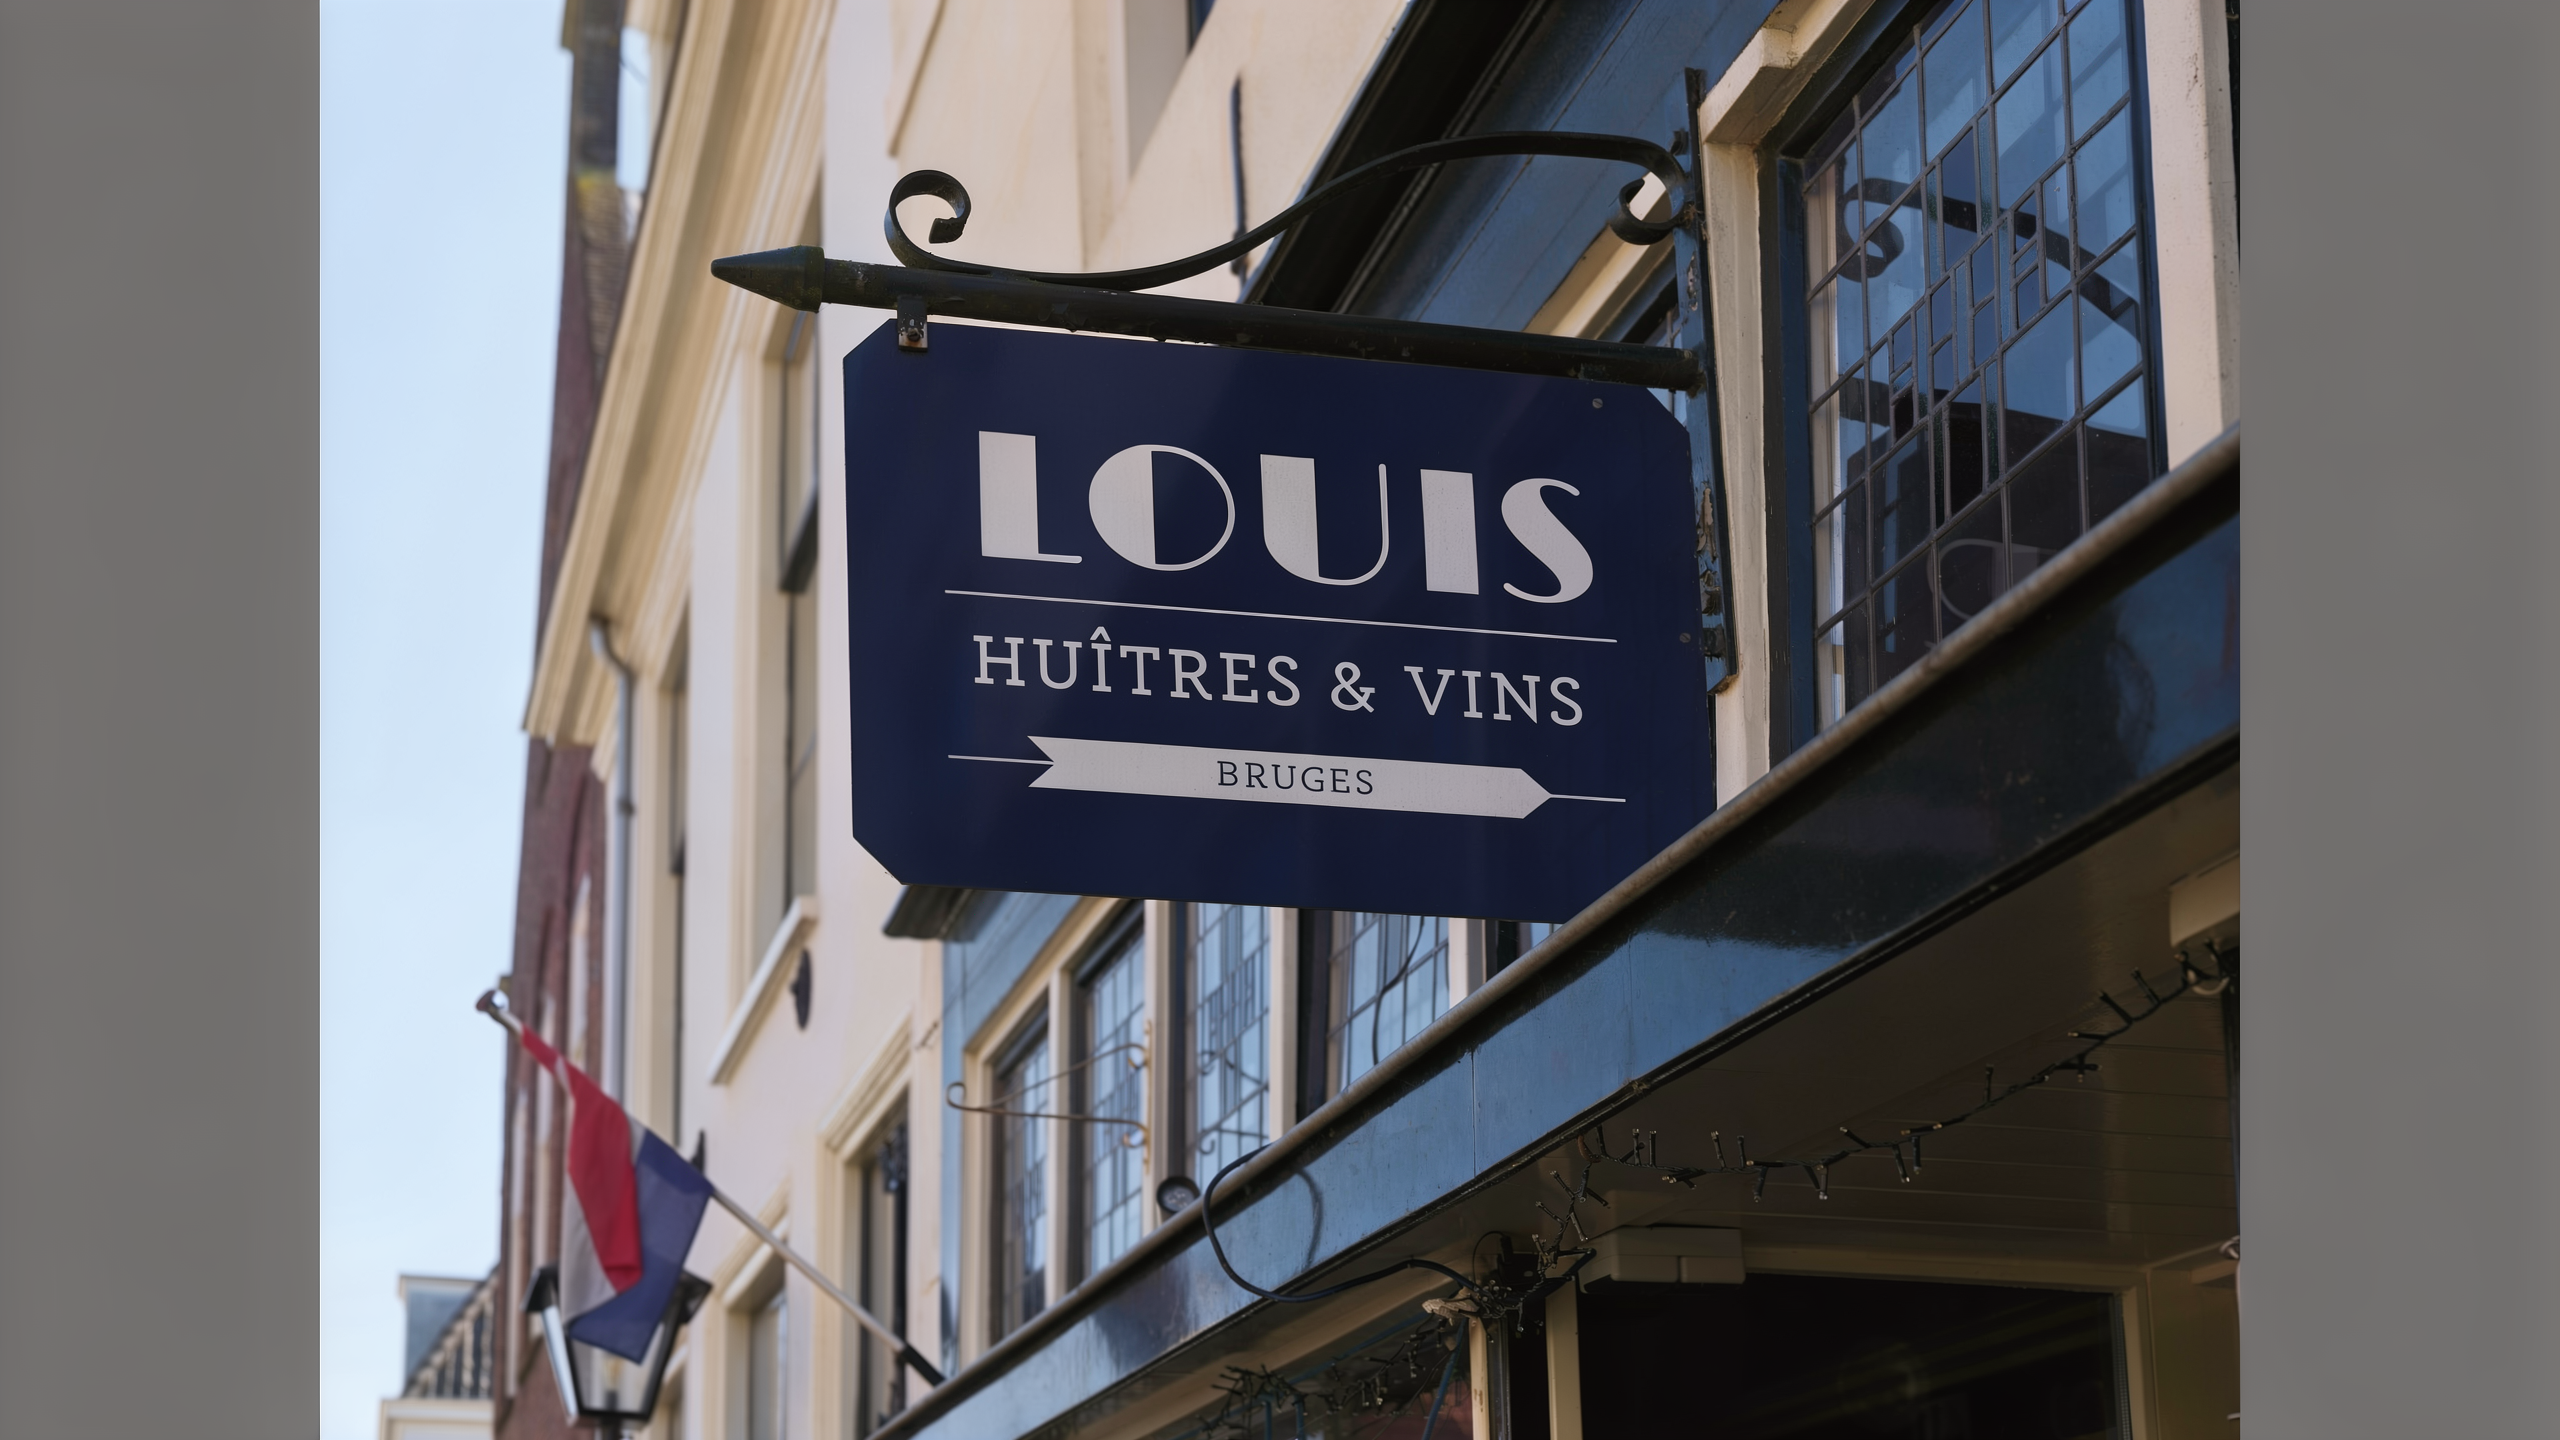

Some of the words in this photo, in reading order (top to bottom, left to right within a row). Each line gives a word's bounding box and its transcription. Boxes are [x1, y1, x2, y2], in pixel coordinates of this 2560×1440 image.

[979, 431, 1593, 603] LOUIS
[973, 627, 1300, 706] HUÎTRES
[1331, 662, 1375, 712] &
[1404, 666, 1582, 726] VINS
[1217, 761, 1373, 794] BRUGES
